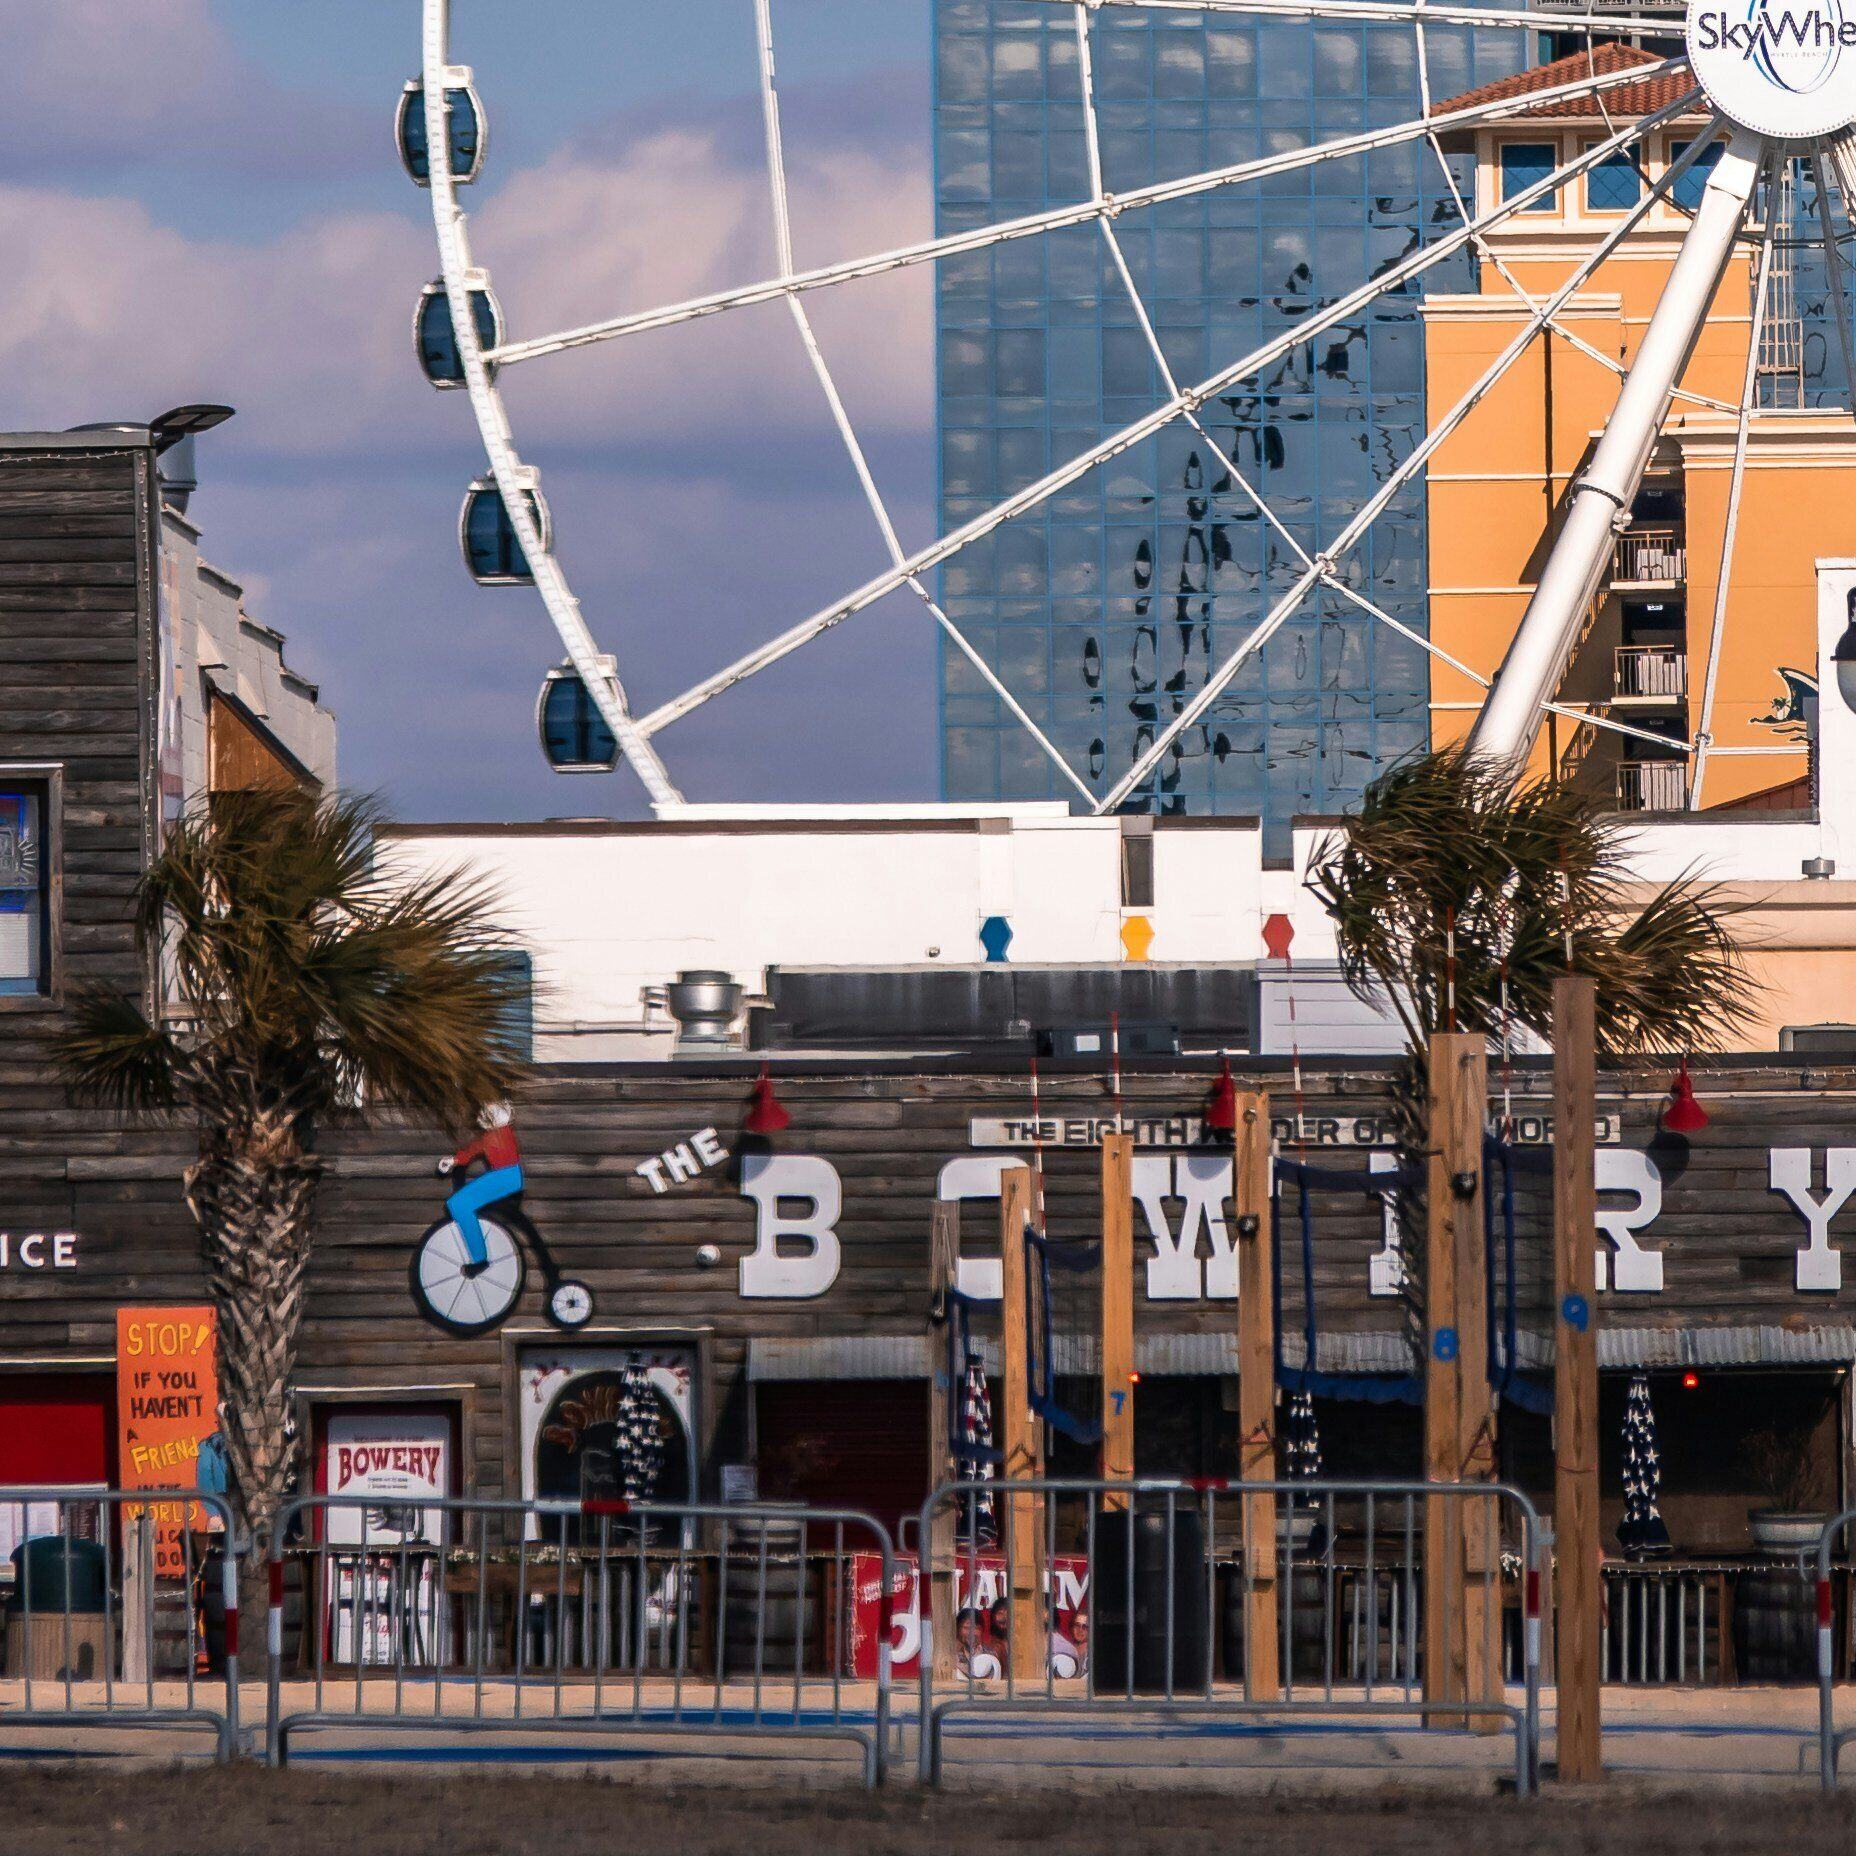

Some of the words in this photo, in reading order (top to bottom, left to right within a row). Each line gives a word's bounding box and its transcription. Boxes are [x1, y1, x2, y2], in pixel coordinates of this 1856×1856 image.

[1004, 1121, 1056, 1141] THE
[1064, 1119, 1187, 1144] EIGHTH
[634, 1126, 730, 1194] THE
[126, 1322, 210, 1356] STOP!
[134, 1372, 151, 1390] IF
[157, 1371, 196, 1390] YOU
[130, 1395, 202, 1420] HAVEN'T
[126, 1427, 138, 1444] A
[337, 1447, 441, 1491] BOWERY
